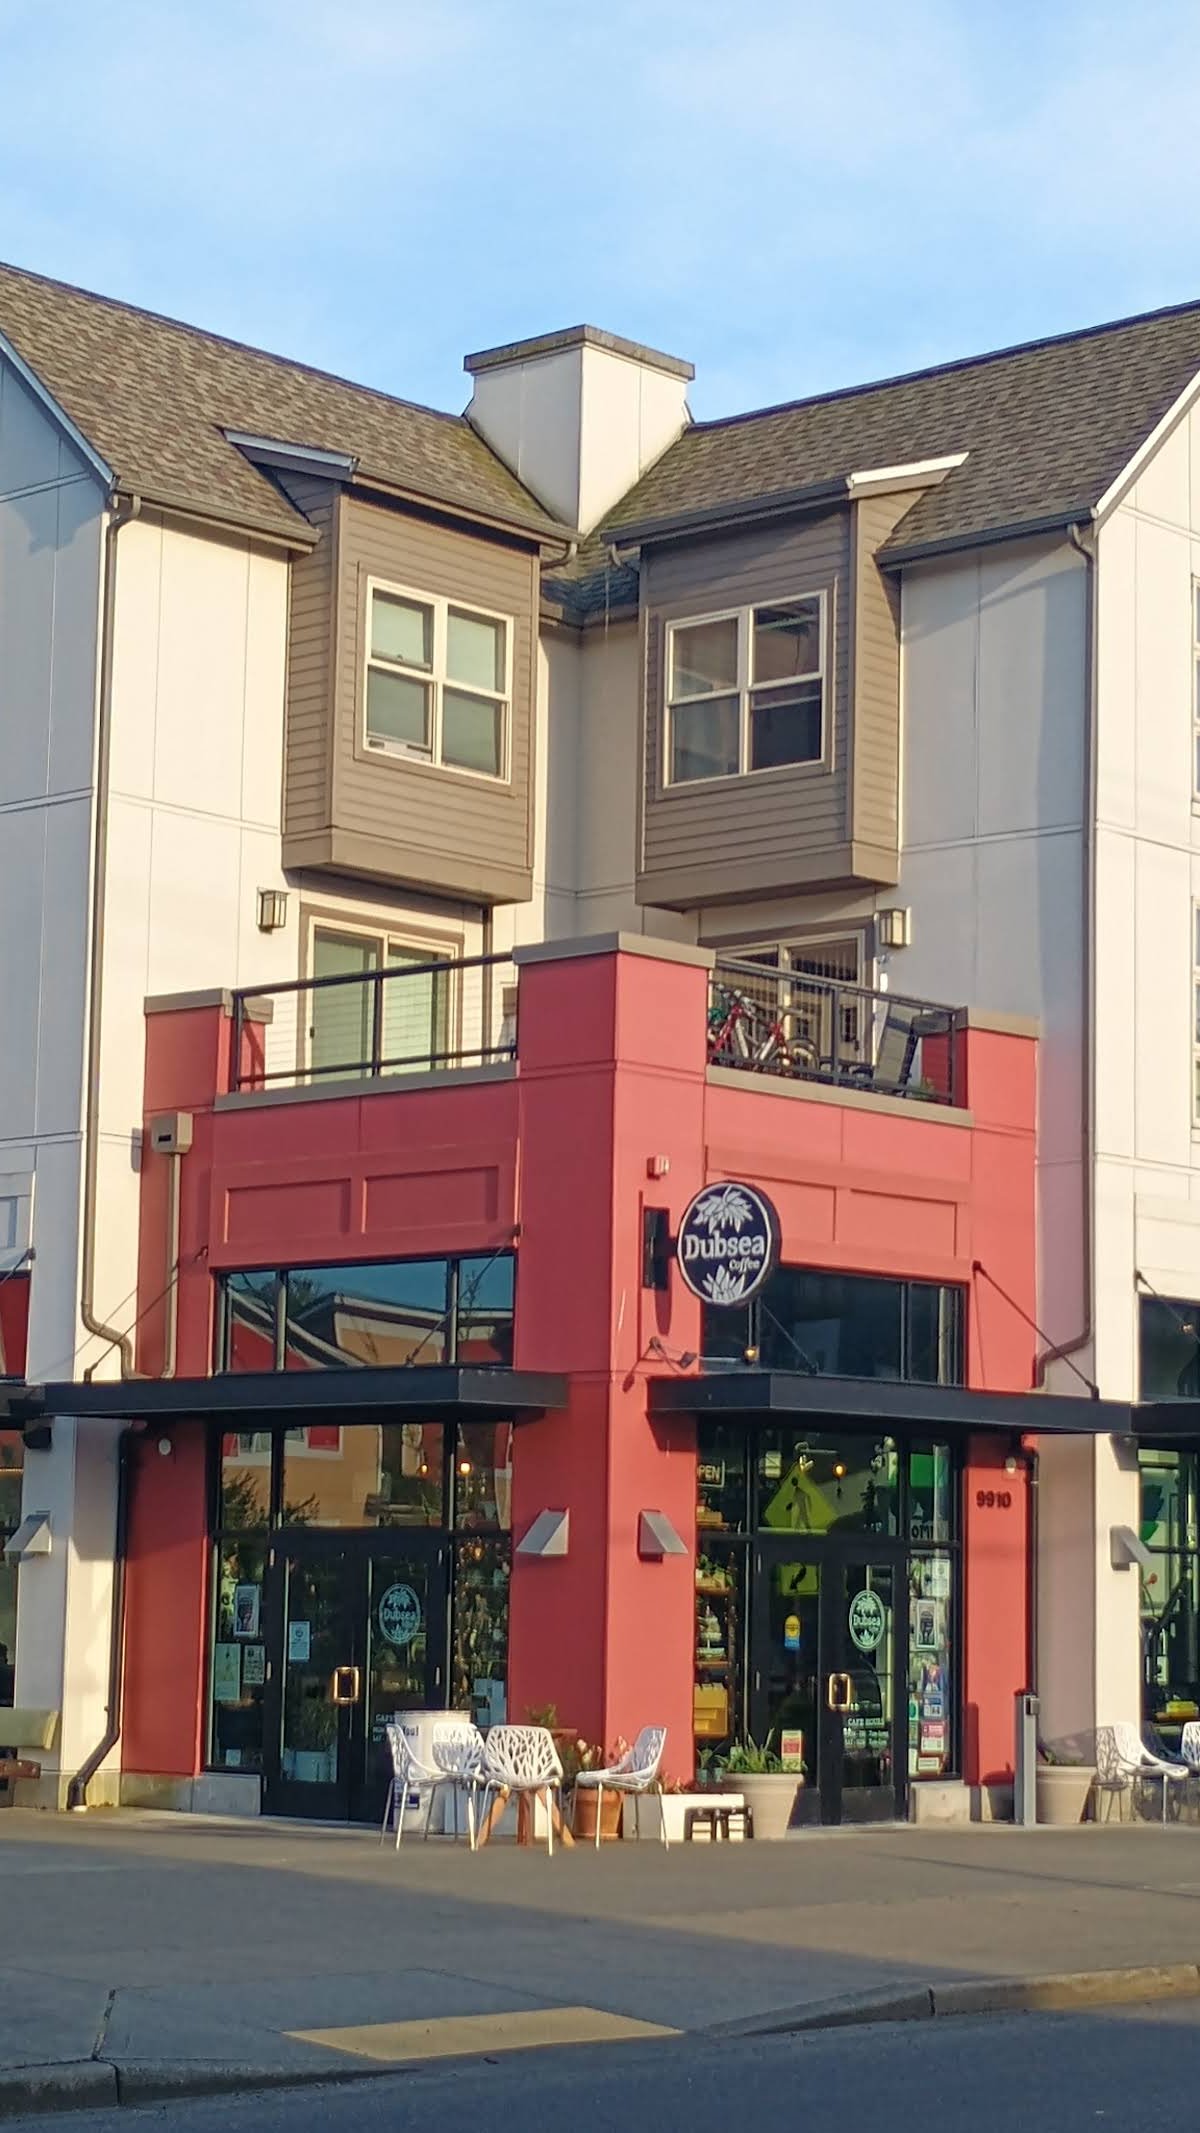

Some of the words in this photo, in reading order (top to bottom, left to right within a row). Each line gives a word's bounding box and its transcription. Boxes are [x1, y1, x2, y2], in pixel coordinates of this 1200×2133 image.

[684, 1230, 765, 1260] Dubsea
[729, 1256, 760, 1272] Coffee
[697, 1464, 720, 1482] PEN
[976, 1490, 1012, 1508] 9910
[383, 1607, 416, 1621] Dubsea
